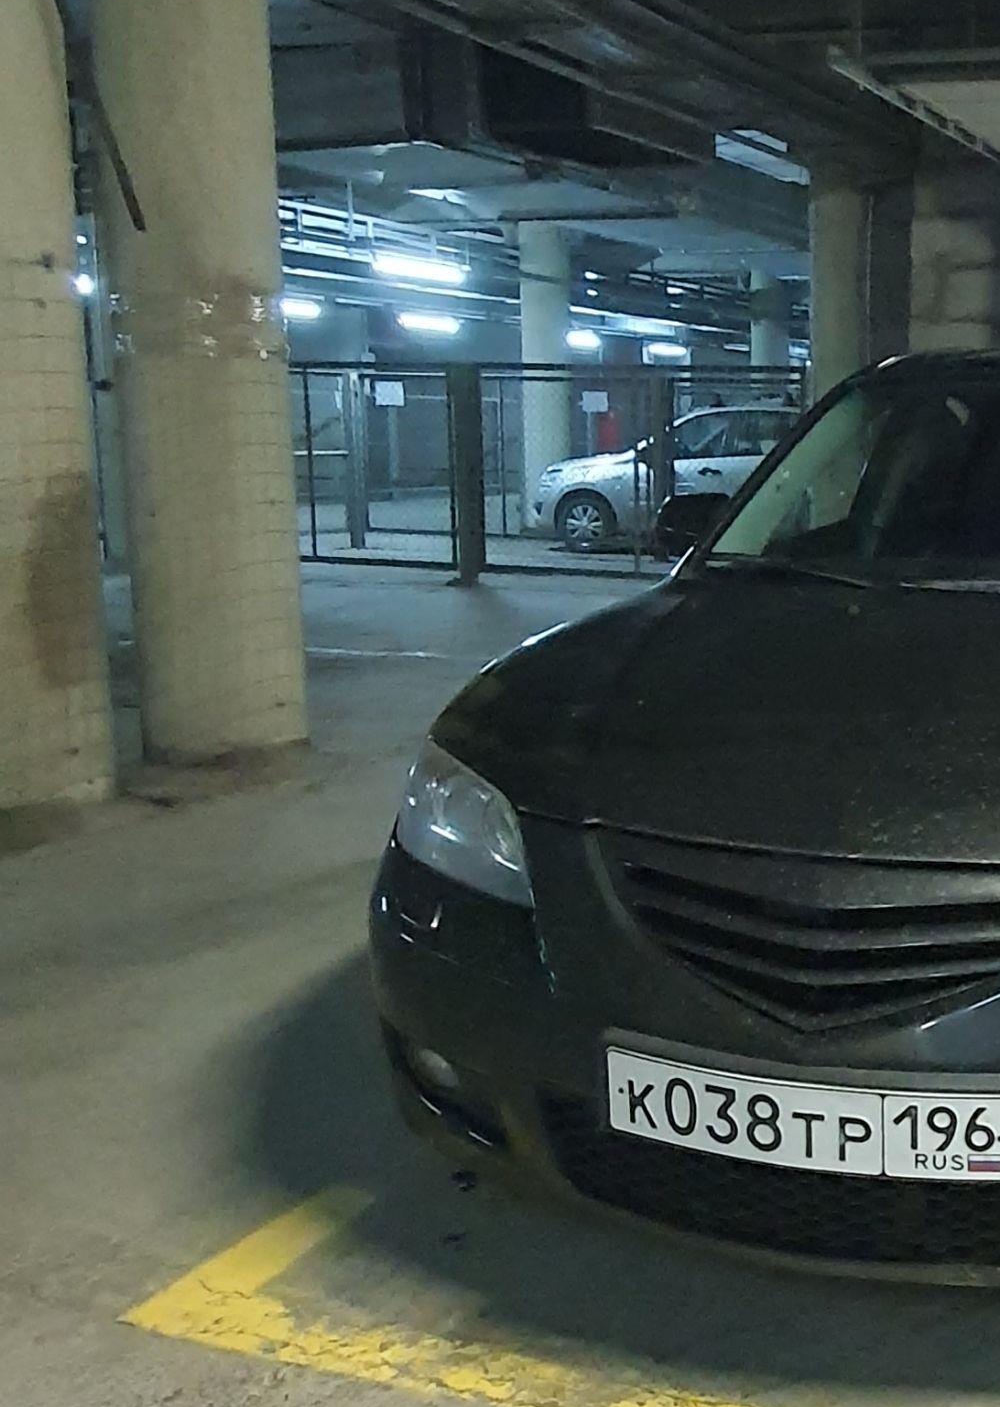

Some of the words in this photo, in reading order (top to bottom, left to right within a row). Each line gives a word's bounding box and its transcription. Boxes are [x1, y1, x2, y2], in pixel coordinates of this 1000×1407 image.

[628, 1077, 872, 1161] К038ТР
[893, 1105, 996, 1152] 196
[914, 1153, 965, 1170] RUS
